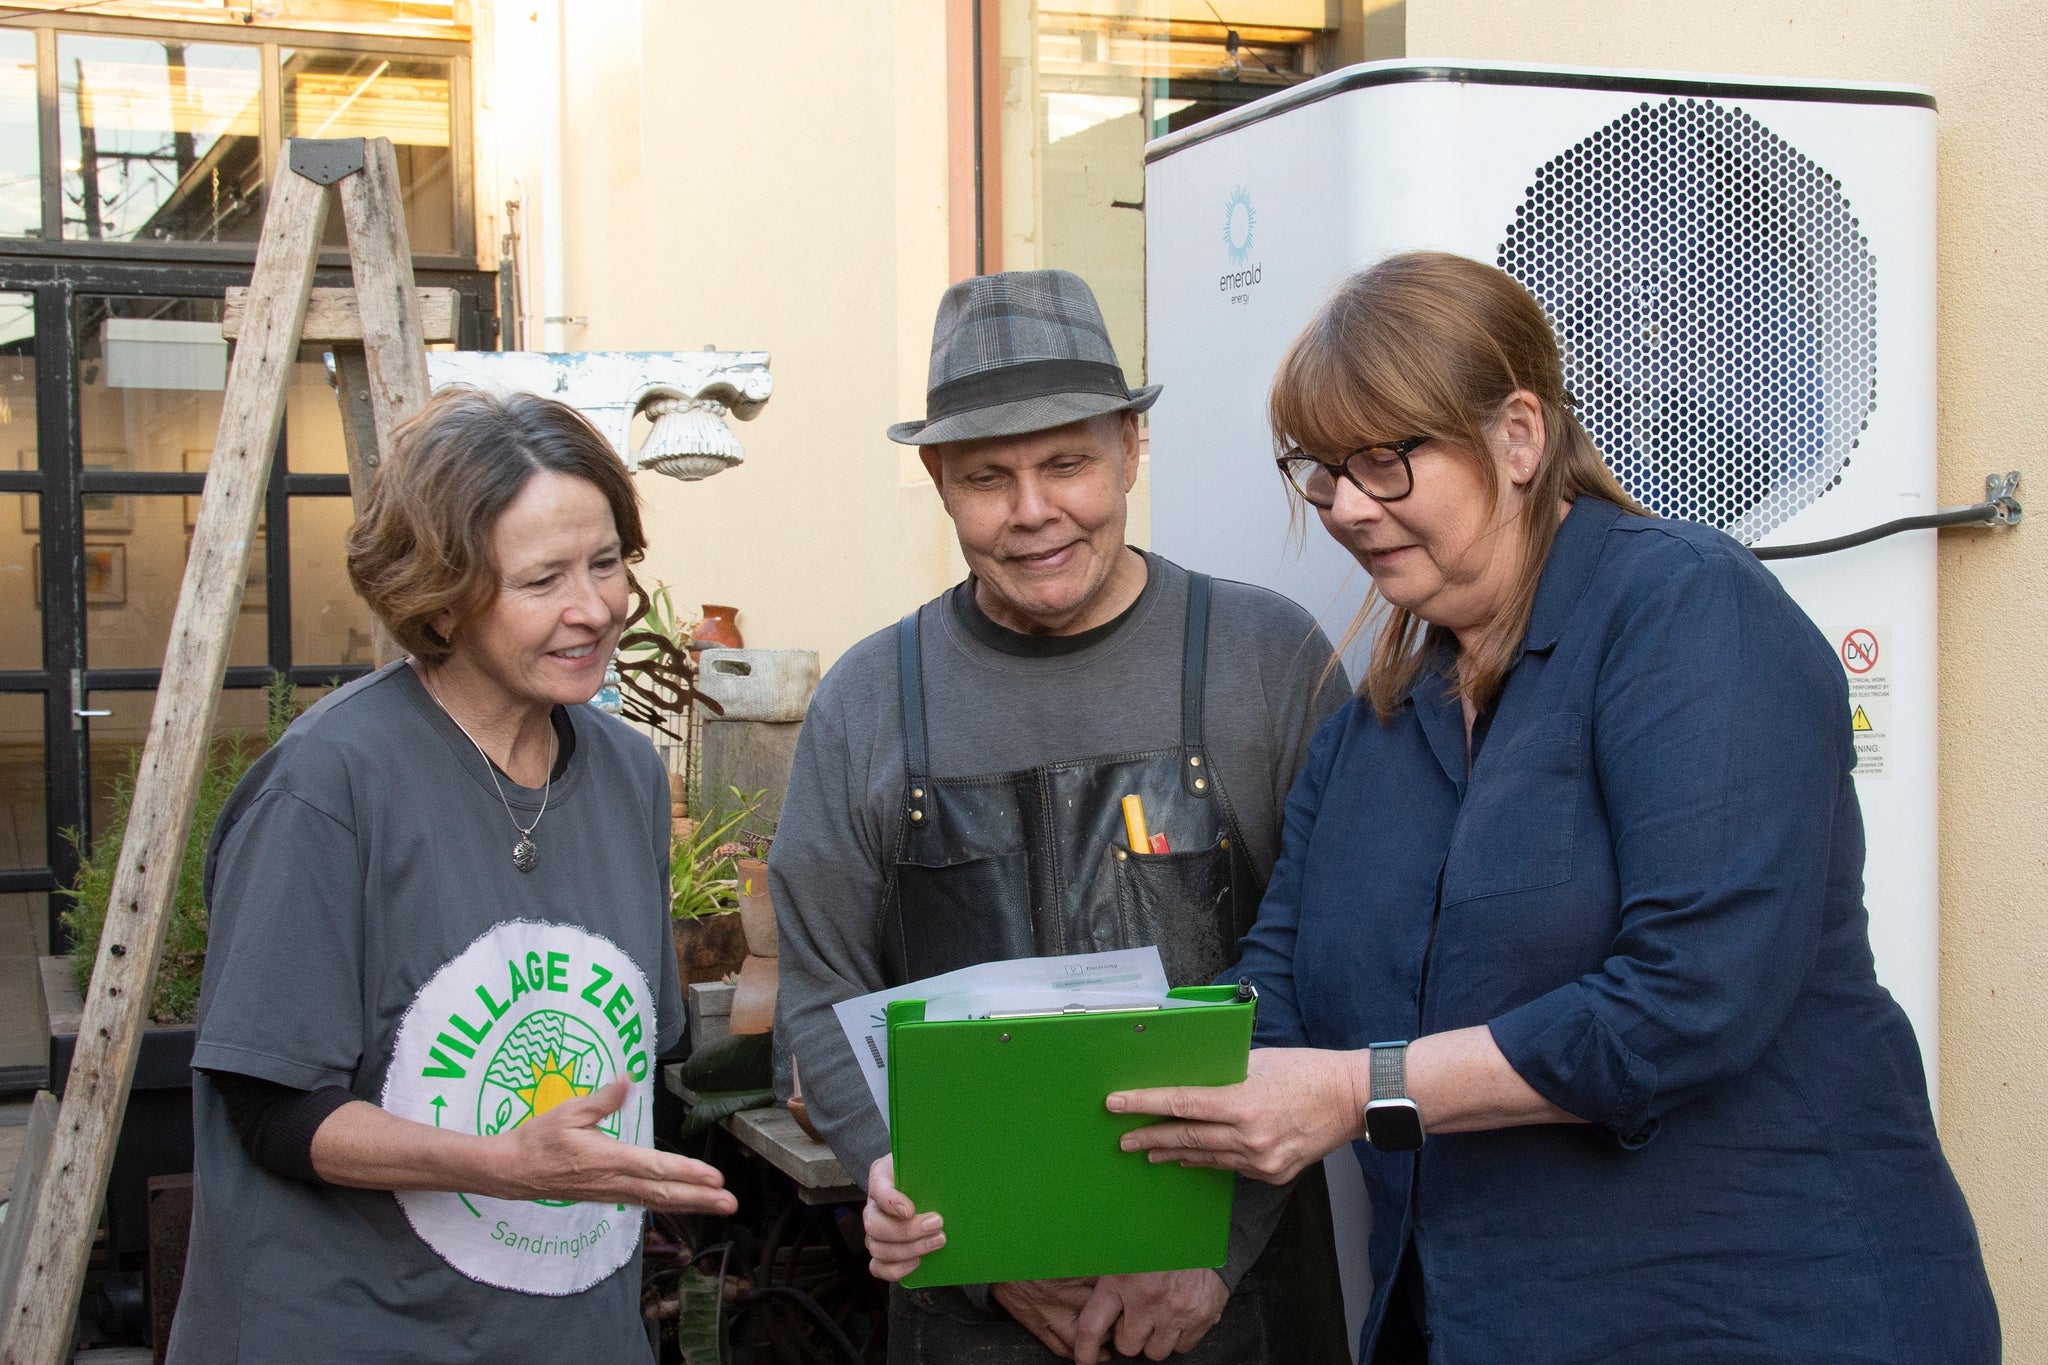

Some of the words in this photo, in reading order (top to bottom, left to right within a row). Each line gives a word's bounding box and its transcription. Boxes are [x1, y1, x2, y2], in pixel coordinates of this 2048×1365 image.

[1220, 262, 1262, 292] emerald
[1231, 293, 1249, 306] energy
[1847, 642, 1874, 660] DIY
[422, 950, 570, 1079] VILLAGE
[580, 962, 649, 1083] ZERO
[490, 1217, 611, 1259] Sandringham
